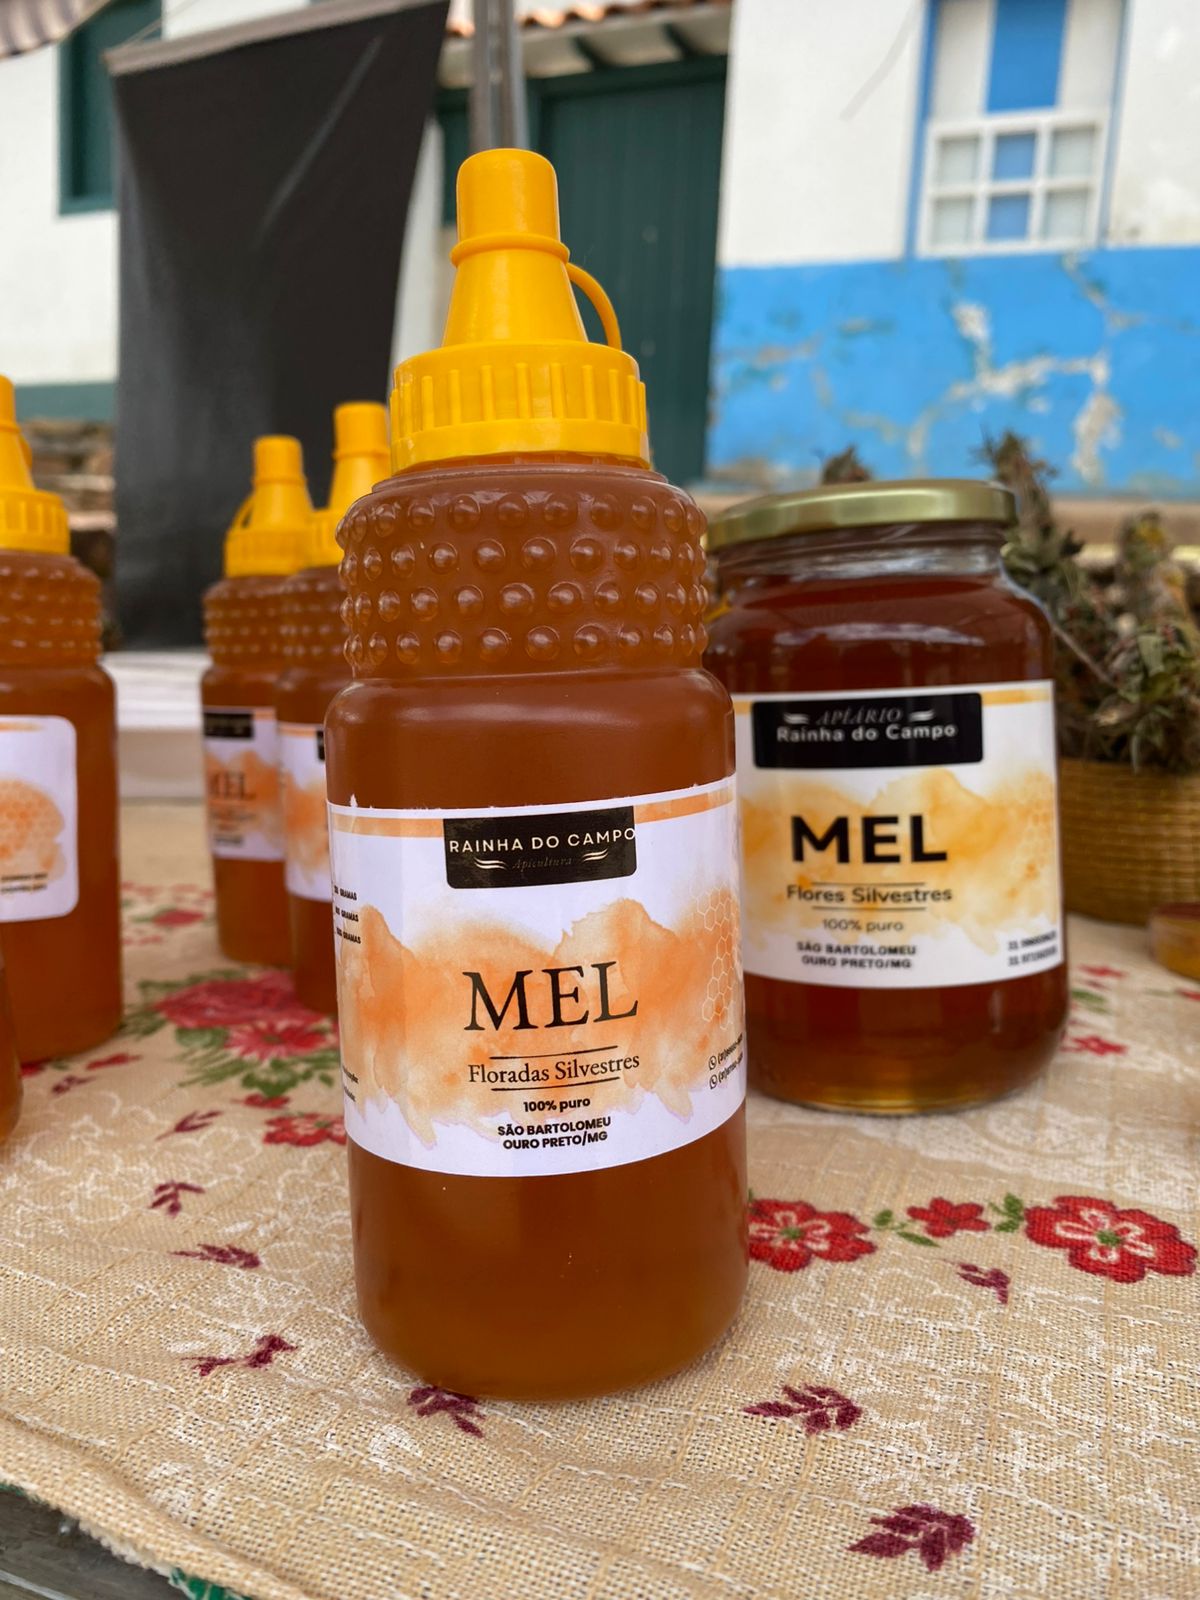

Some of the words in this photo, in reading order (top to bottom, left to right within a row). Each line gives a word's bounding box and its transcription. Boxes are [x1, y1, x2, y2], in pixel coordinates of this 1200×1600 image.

[776, 726, 845, 743] Rainha
[851, 725, 879, 741] do
[885, 723, 958, 741] Campo
[450, 838, 523, 853] RAINHA
[532, 836, 559, 850] DO
[567, 828, 635, 848] CAMPO
[791, 814, 948, 864] MEL
[512, 856, 574, 872] Apicultura
[786, 885, 845, 902] Flores
[852, 886, 953, 903] Silvestres
[823, 918, 861, 931] 100%
[865, 920, 904, 933] puro
[826, 943, 916, 956] BARTOLOMEU
[801, 955, 836, 967] OURO
[841, 956, 912, 969] PRETO/MG
[462, 961, 638, 1031] MEL
[468, 1063, 550, 1083] Floradas
[555, 1055, 640, 1080] Silvestres
[523, 1100, 557, 1112] 100%
[559, 1098, 591, 1112] puro
[497, 1122, 525, 1136] SÃO
[526, 1116, 611, 1135] BARTOLOMEU
[502, 1138, 540, 1150] OURO
[542, 1131, 608, 1148] PRETO/MG
